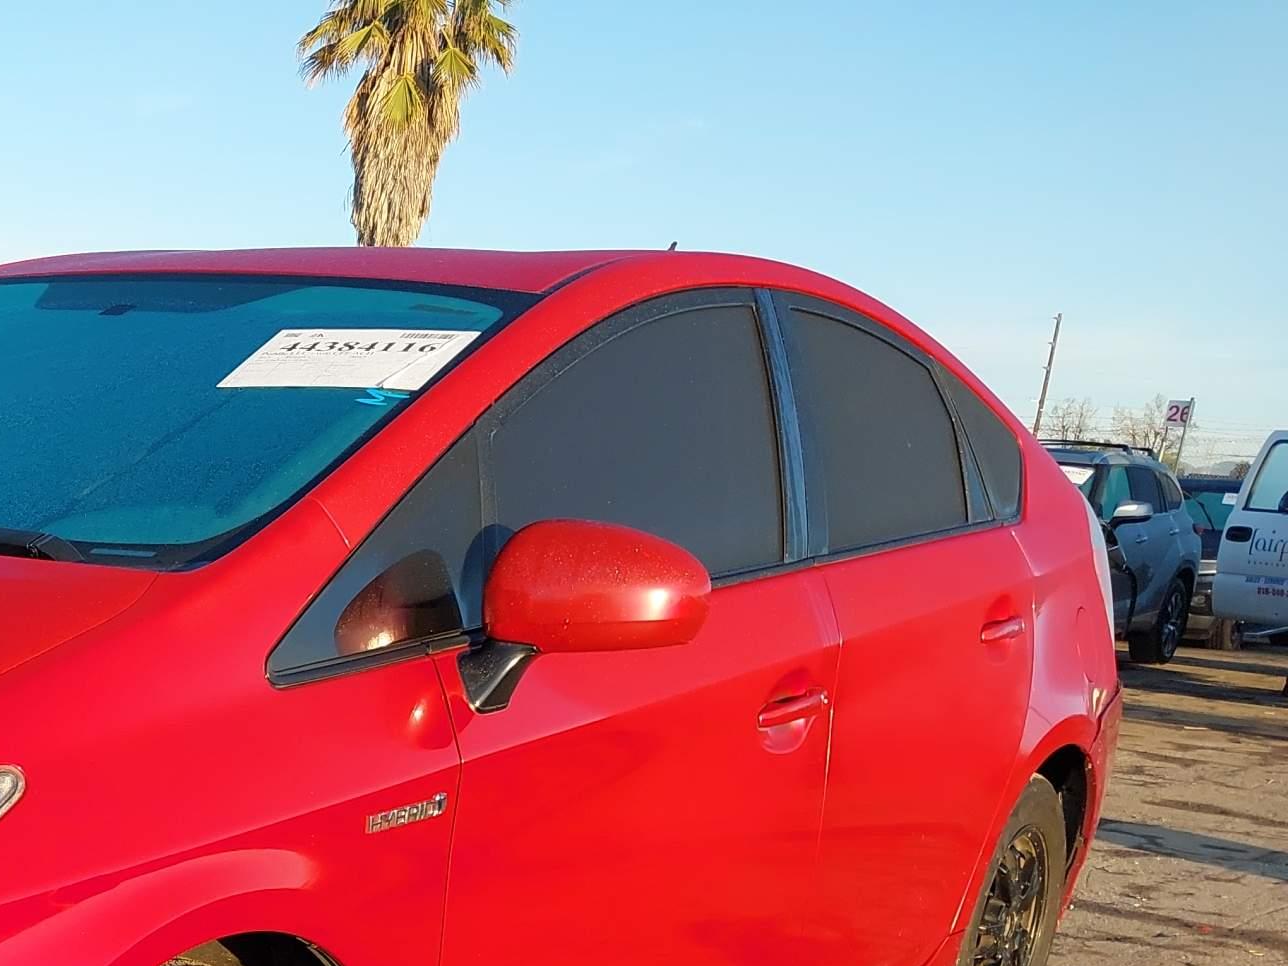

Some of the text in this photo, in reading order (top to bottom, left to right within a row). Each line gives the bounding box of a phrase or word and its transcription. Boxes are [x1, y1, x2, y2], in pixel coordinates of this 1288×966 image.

[280, 340, 440, 352] 44384116
[1167, 405, 1190, 423] 26
[365, 792, 447, 834] HYBRID
